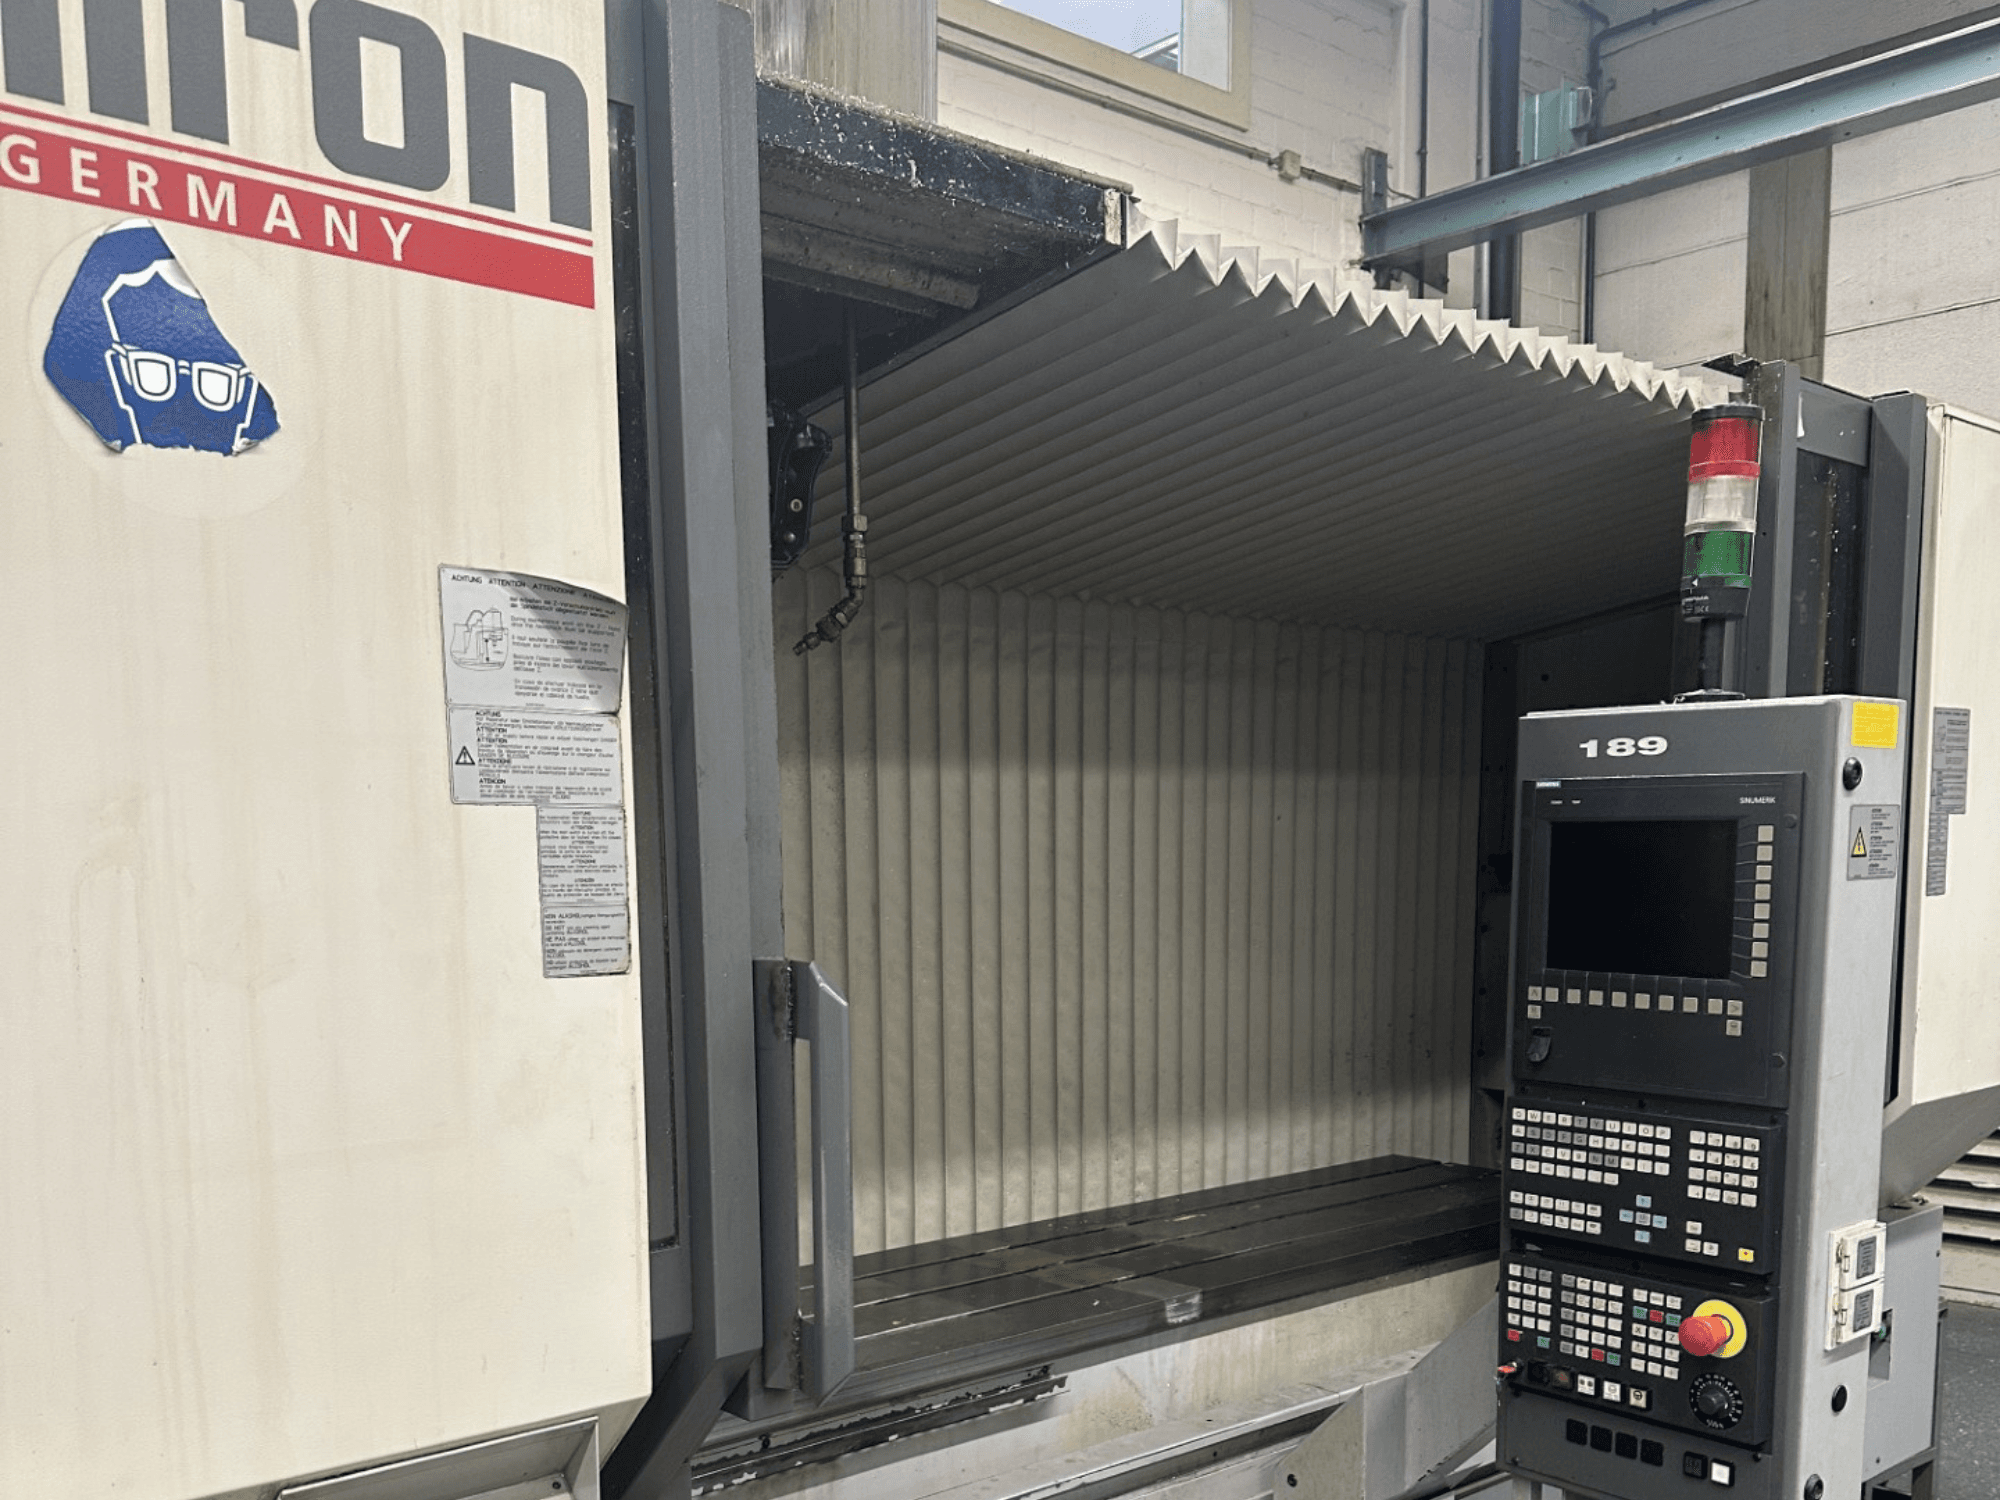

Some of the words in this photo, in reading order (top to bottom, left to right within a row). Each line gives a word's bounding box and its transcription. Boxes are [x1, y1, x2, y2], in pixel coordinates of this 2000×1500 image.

[0, 133, 413, 262] GERMANY
[452, 574, 482, 584] ACHTUNG
[488, 577, 526, 588] ATTENTION
[1579, 736, 1668, 758] 189
